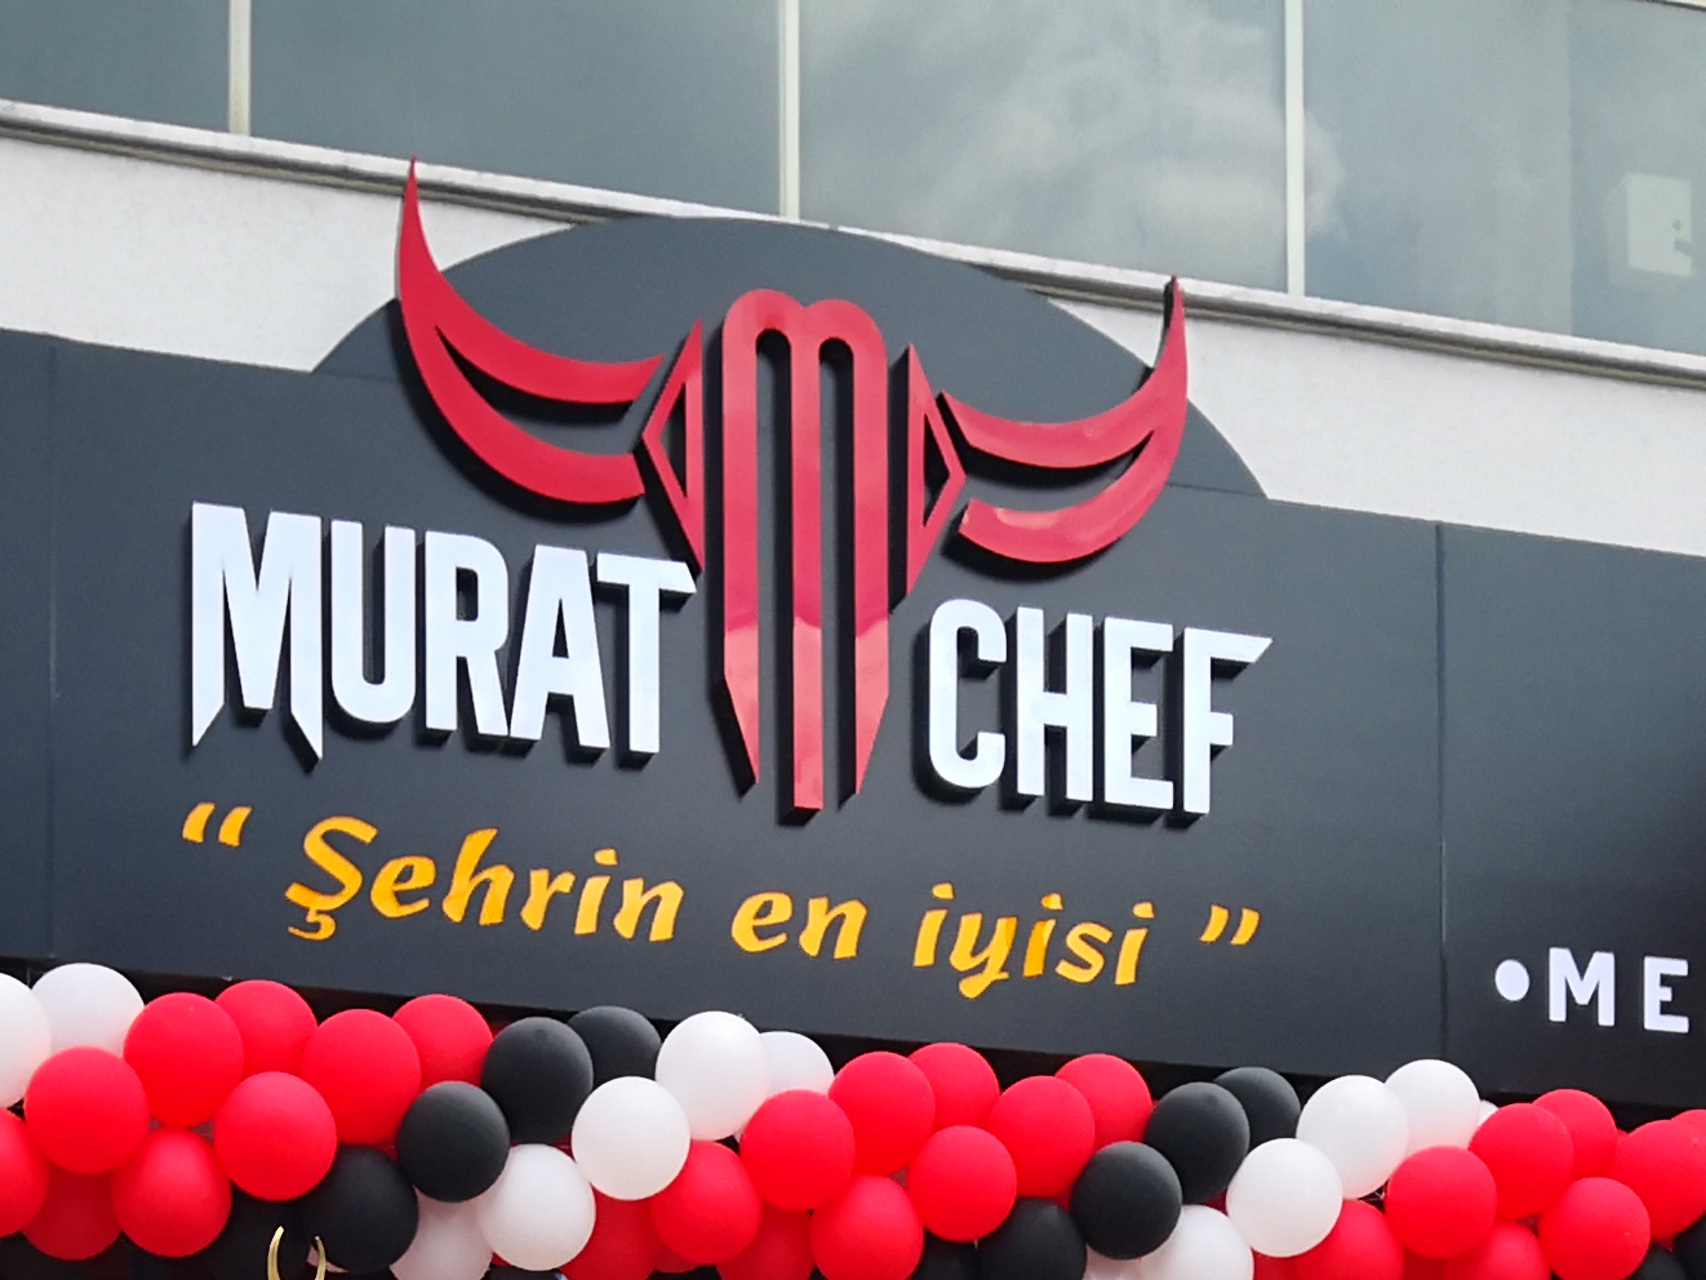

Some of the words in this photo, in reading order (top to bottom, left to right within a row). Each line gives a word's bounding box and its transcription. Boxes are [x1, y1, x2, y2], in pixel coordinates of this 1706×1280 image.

[192, 503, 697, 759] MURAT
[930, 599, 1272, 814] CHEF
[732, 892, 863, 959] en
